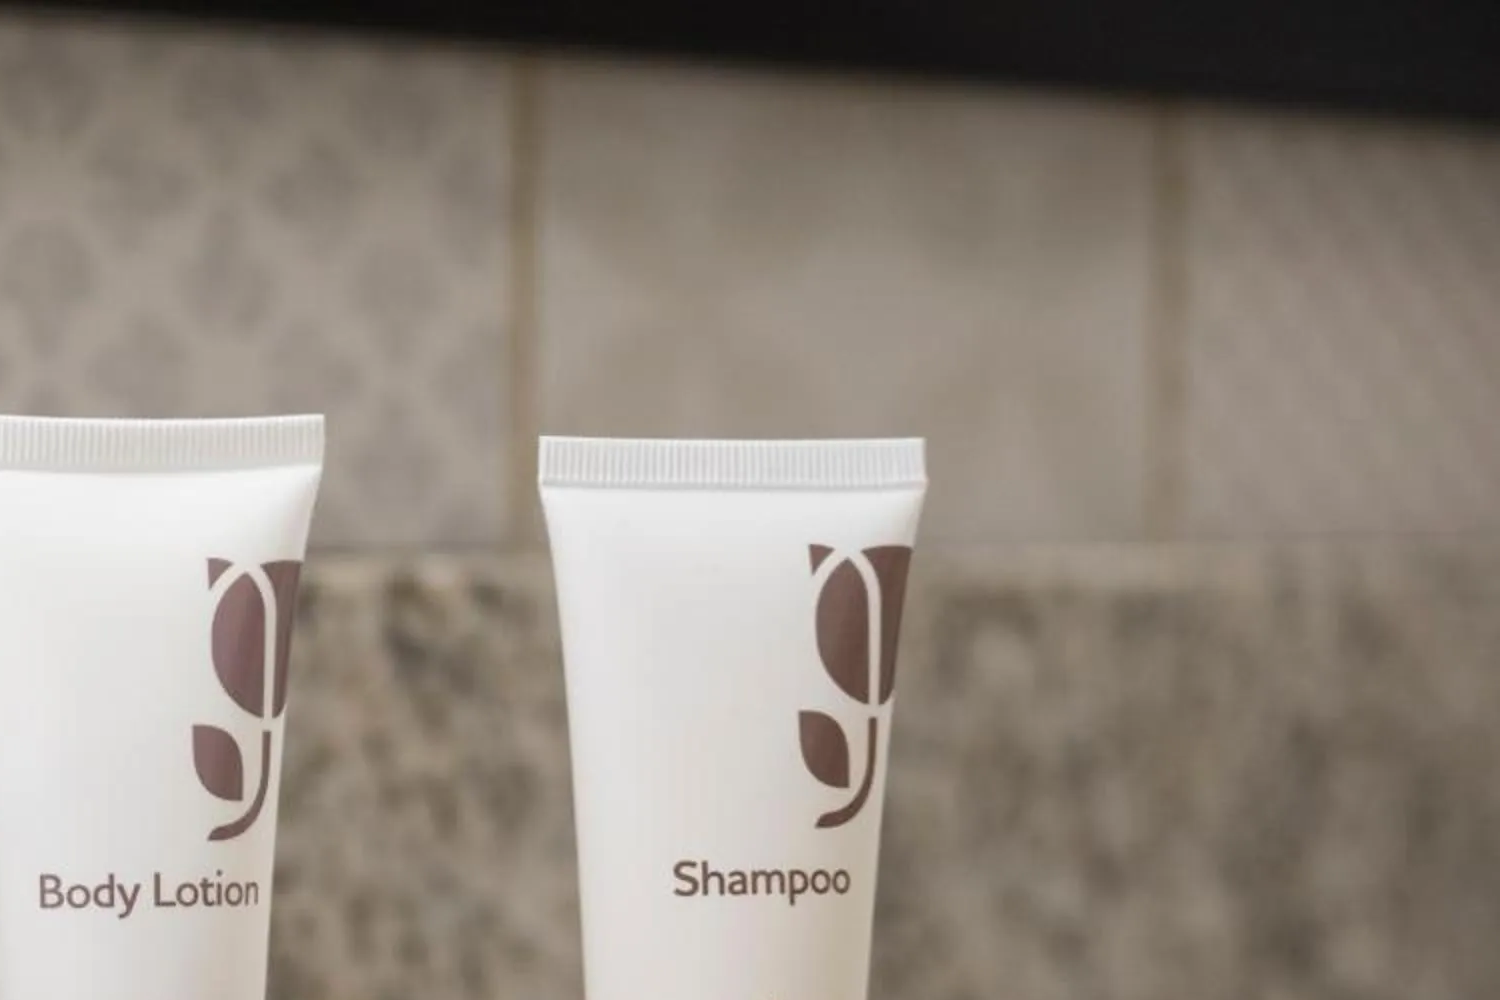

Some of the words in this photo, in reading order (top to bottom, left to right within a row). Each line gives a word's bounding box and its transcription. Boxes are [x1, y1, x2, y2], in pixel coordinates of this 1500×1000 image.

[38, 872, 142, 920] Body
[153, 869, 259, 908] Lotion
[672, 860, 851, 907] Shampoo
